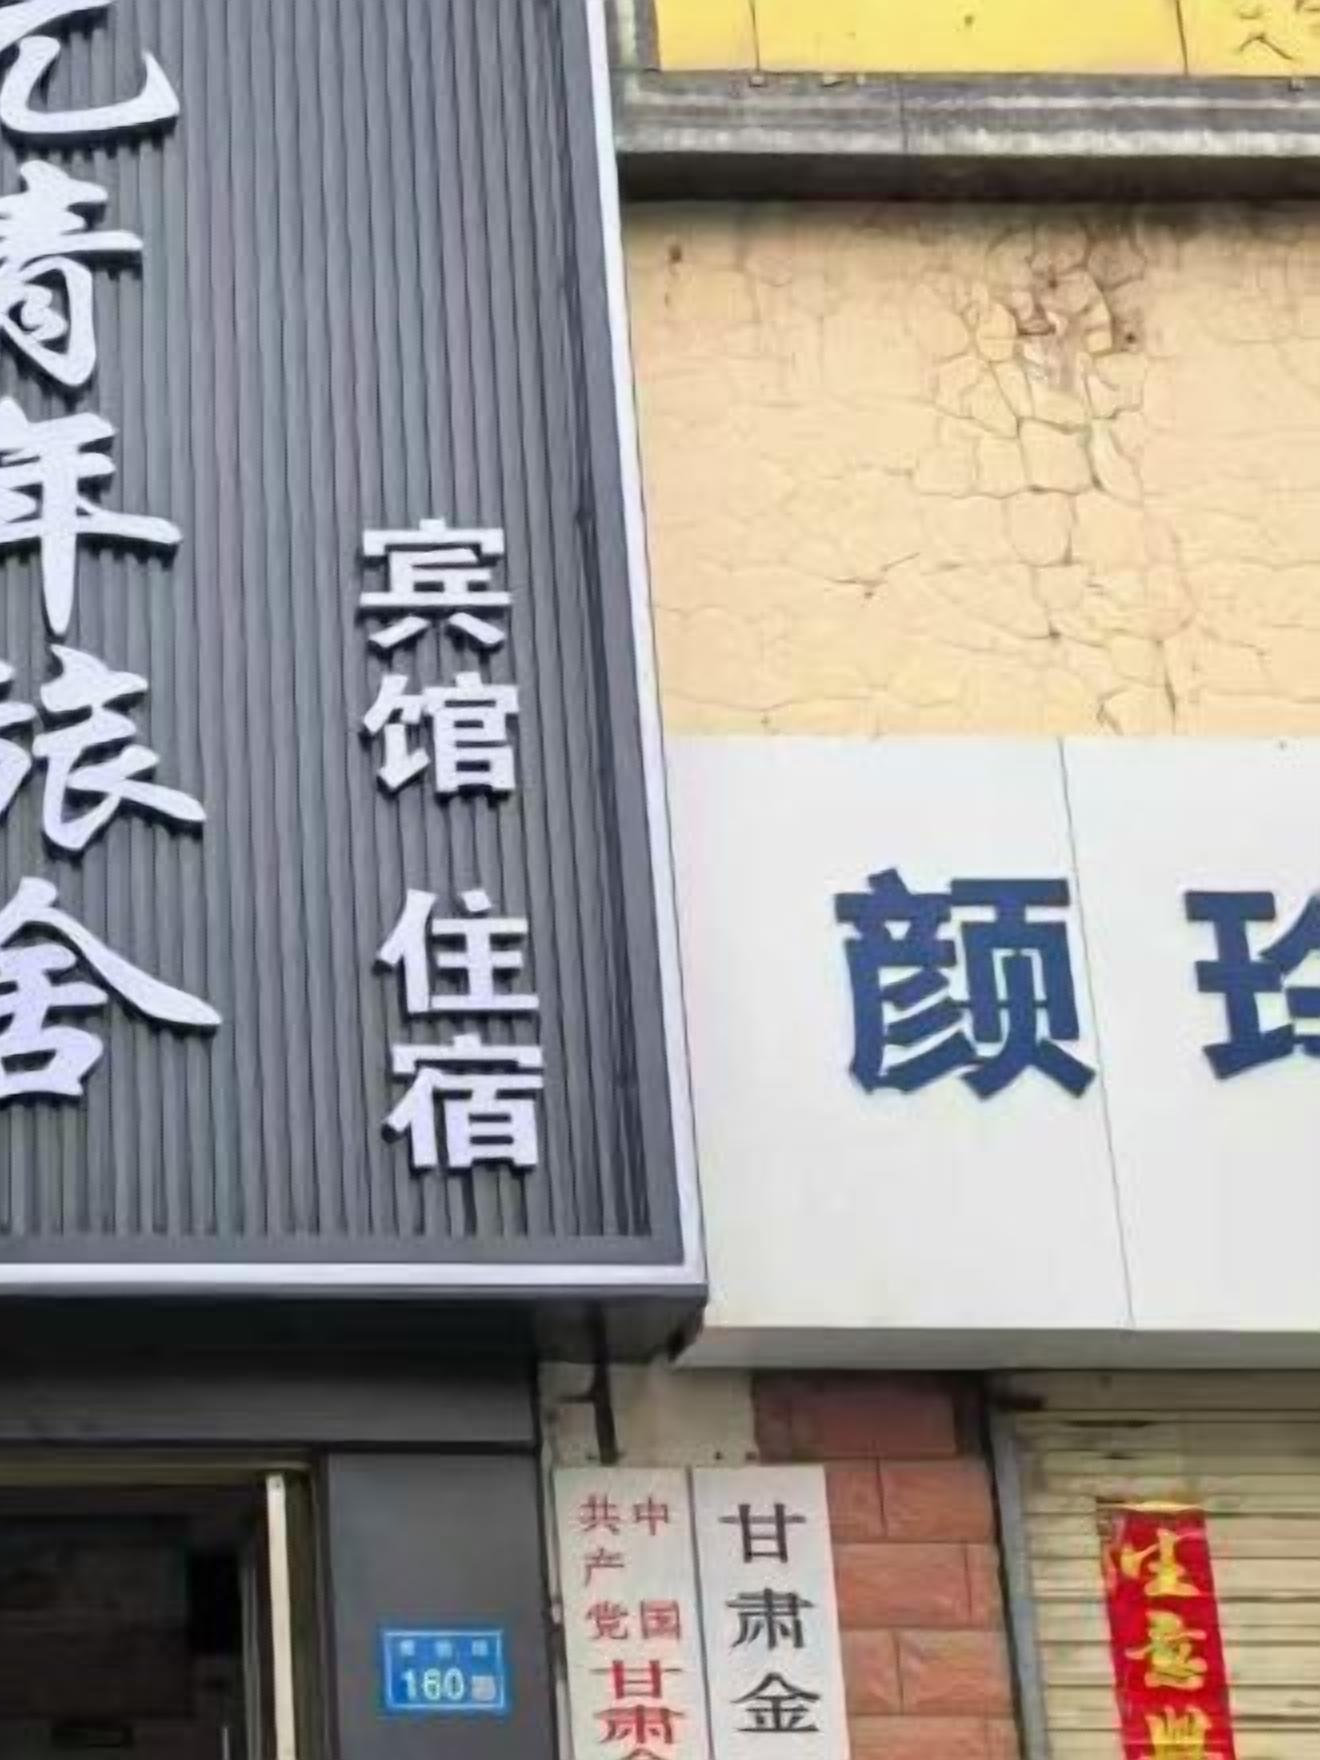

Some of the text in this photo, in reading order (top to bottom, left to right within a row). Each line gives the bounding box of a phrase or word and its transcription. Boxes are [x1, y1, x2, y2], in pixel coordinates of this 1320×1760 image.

[360, 518, 544, 1169] 宾馆 住宿
[590, 1659, 685, 1760] 甘肃
[718, 1503, 821, 1733] 甘肃金
